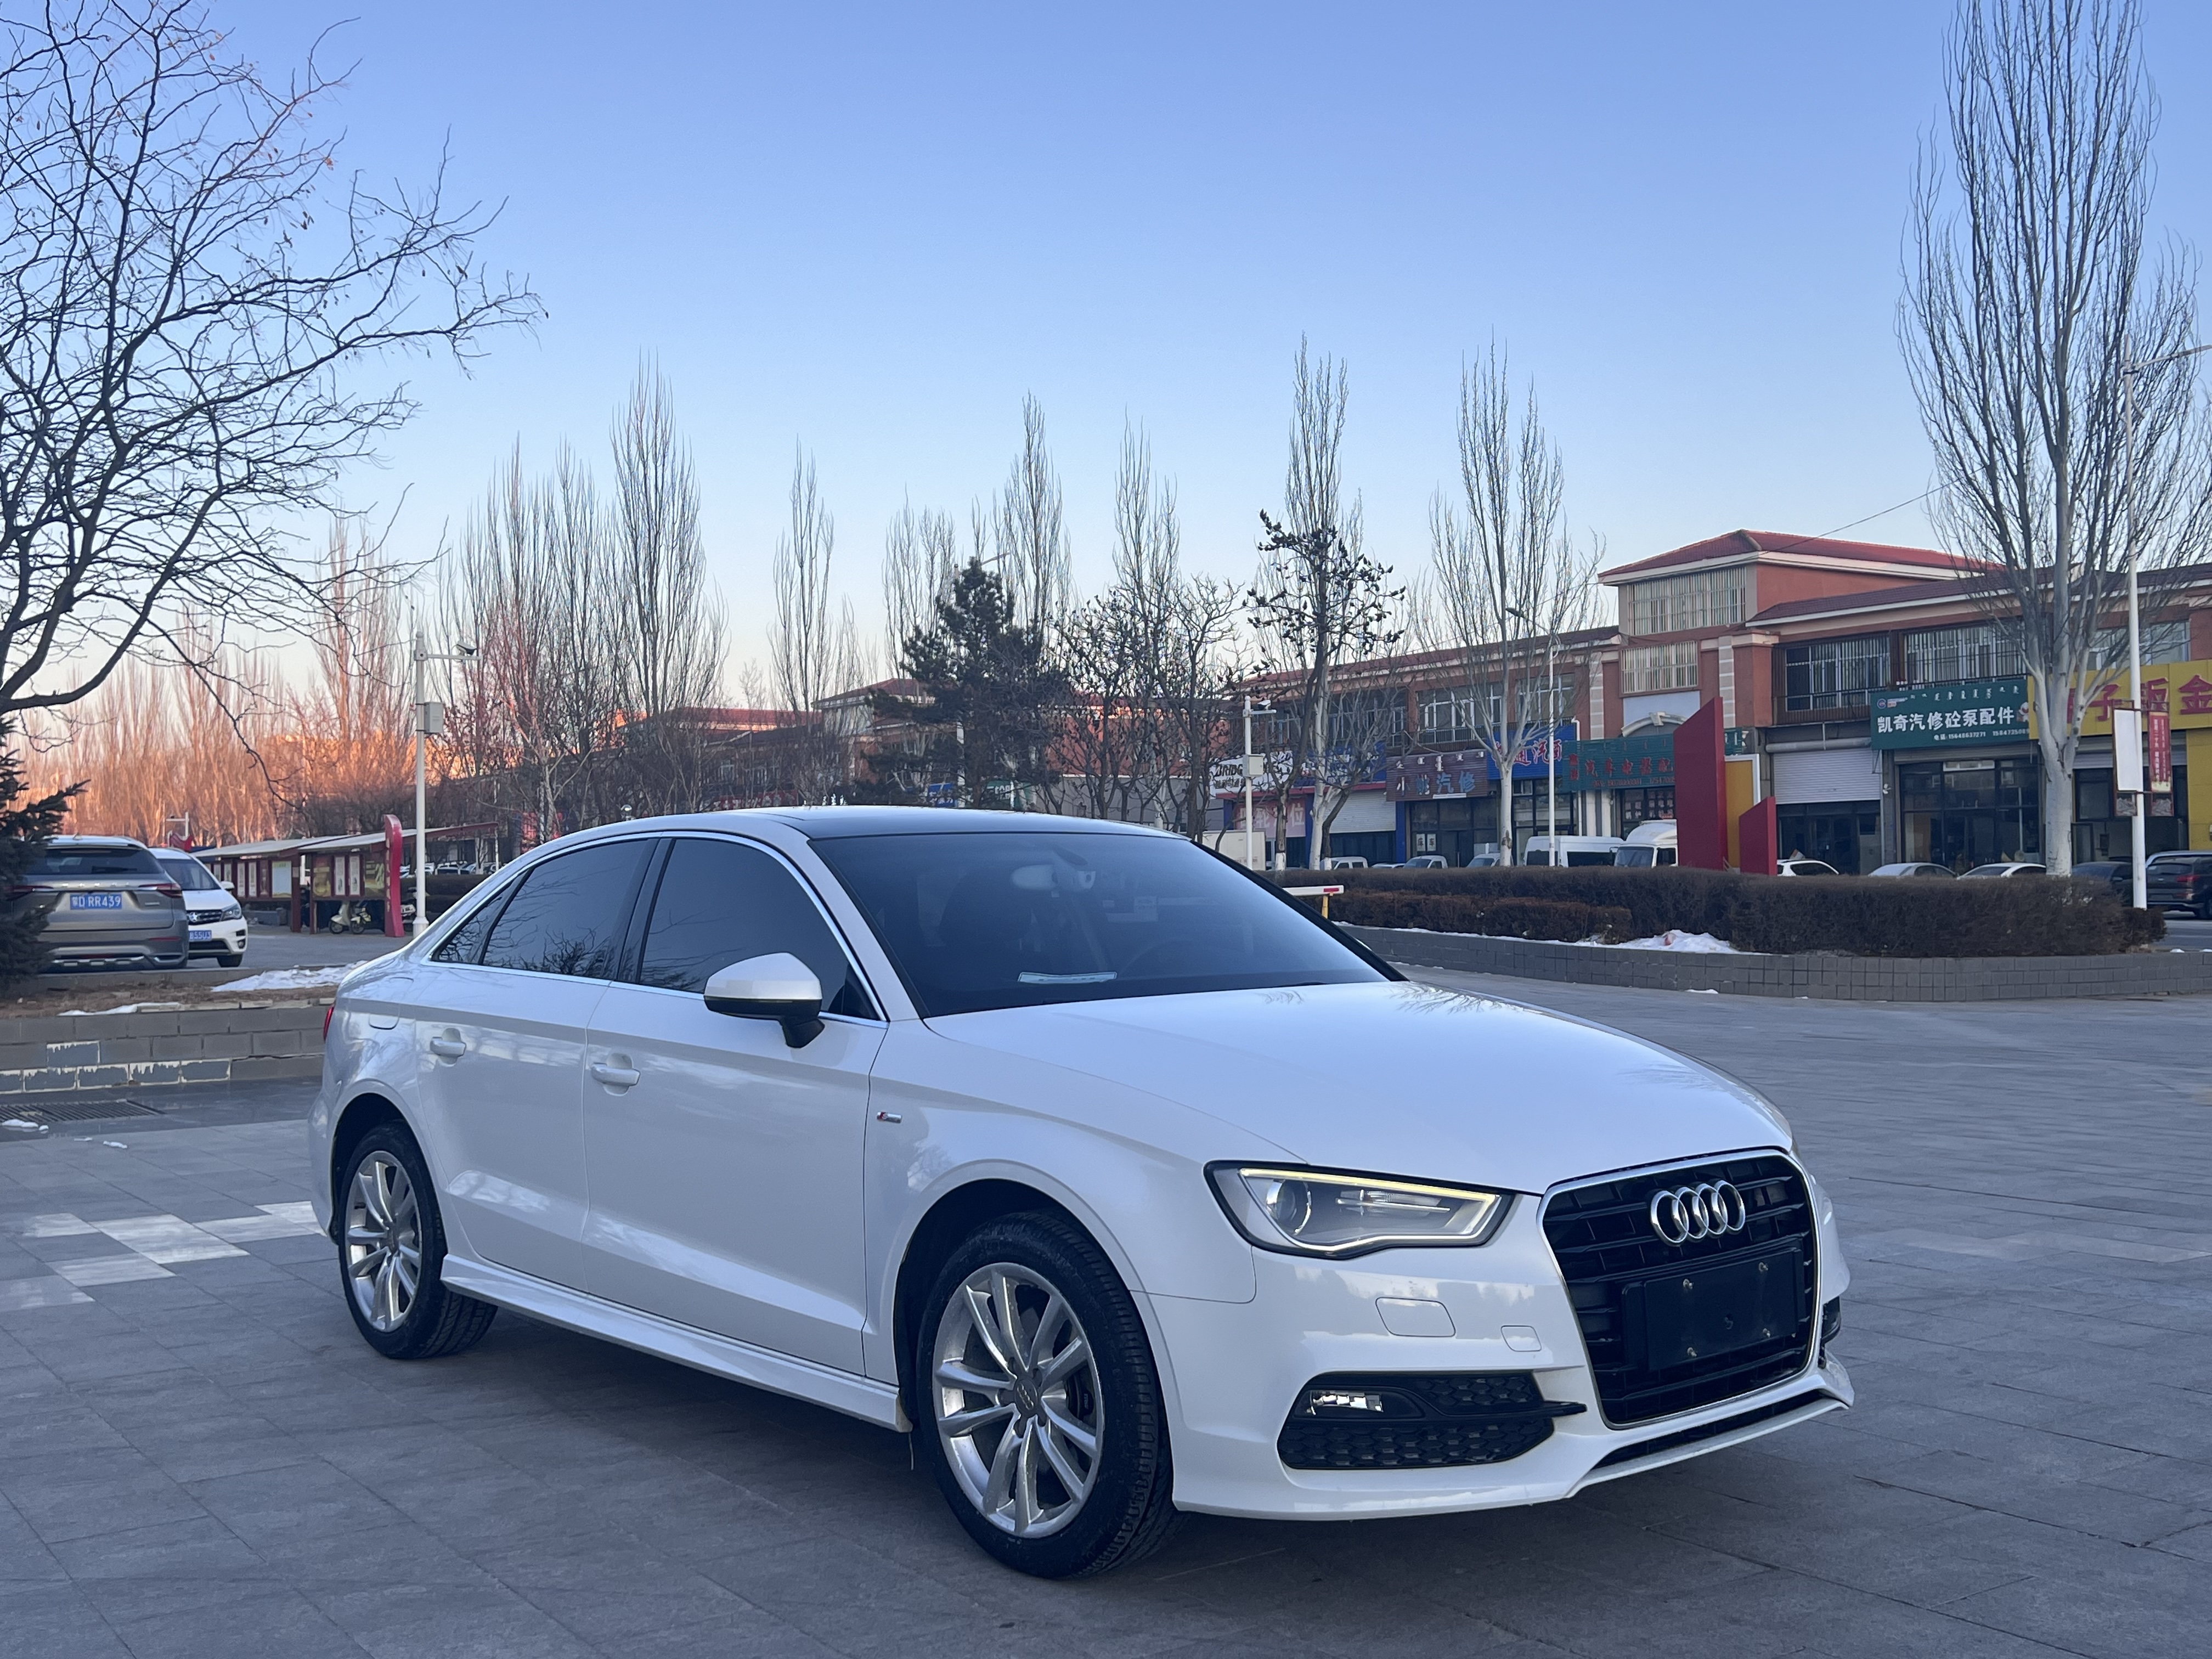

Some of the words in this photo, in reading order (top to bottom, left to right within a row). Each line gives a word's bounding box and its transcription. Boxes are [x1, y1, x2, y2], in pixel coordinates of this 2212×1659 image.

[2067, 675, 2212, 723] 子钣金
[1877, 706, 2015, 733] 凯奇汽修砼泵配件
[1240, 803, 1305, 829] 轮位
